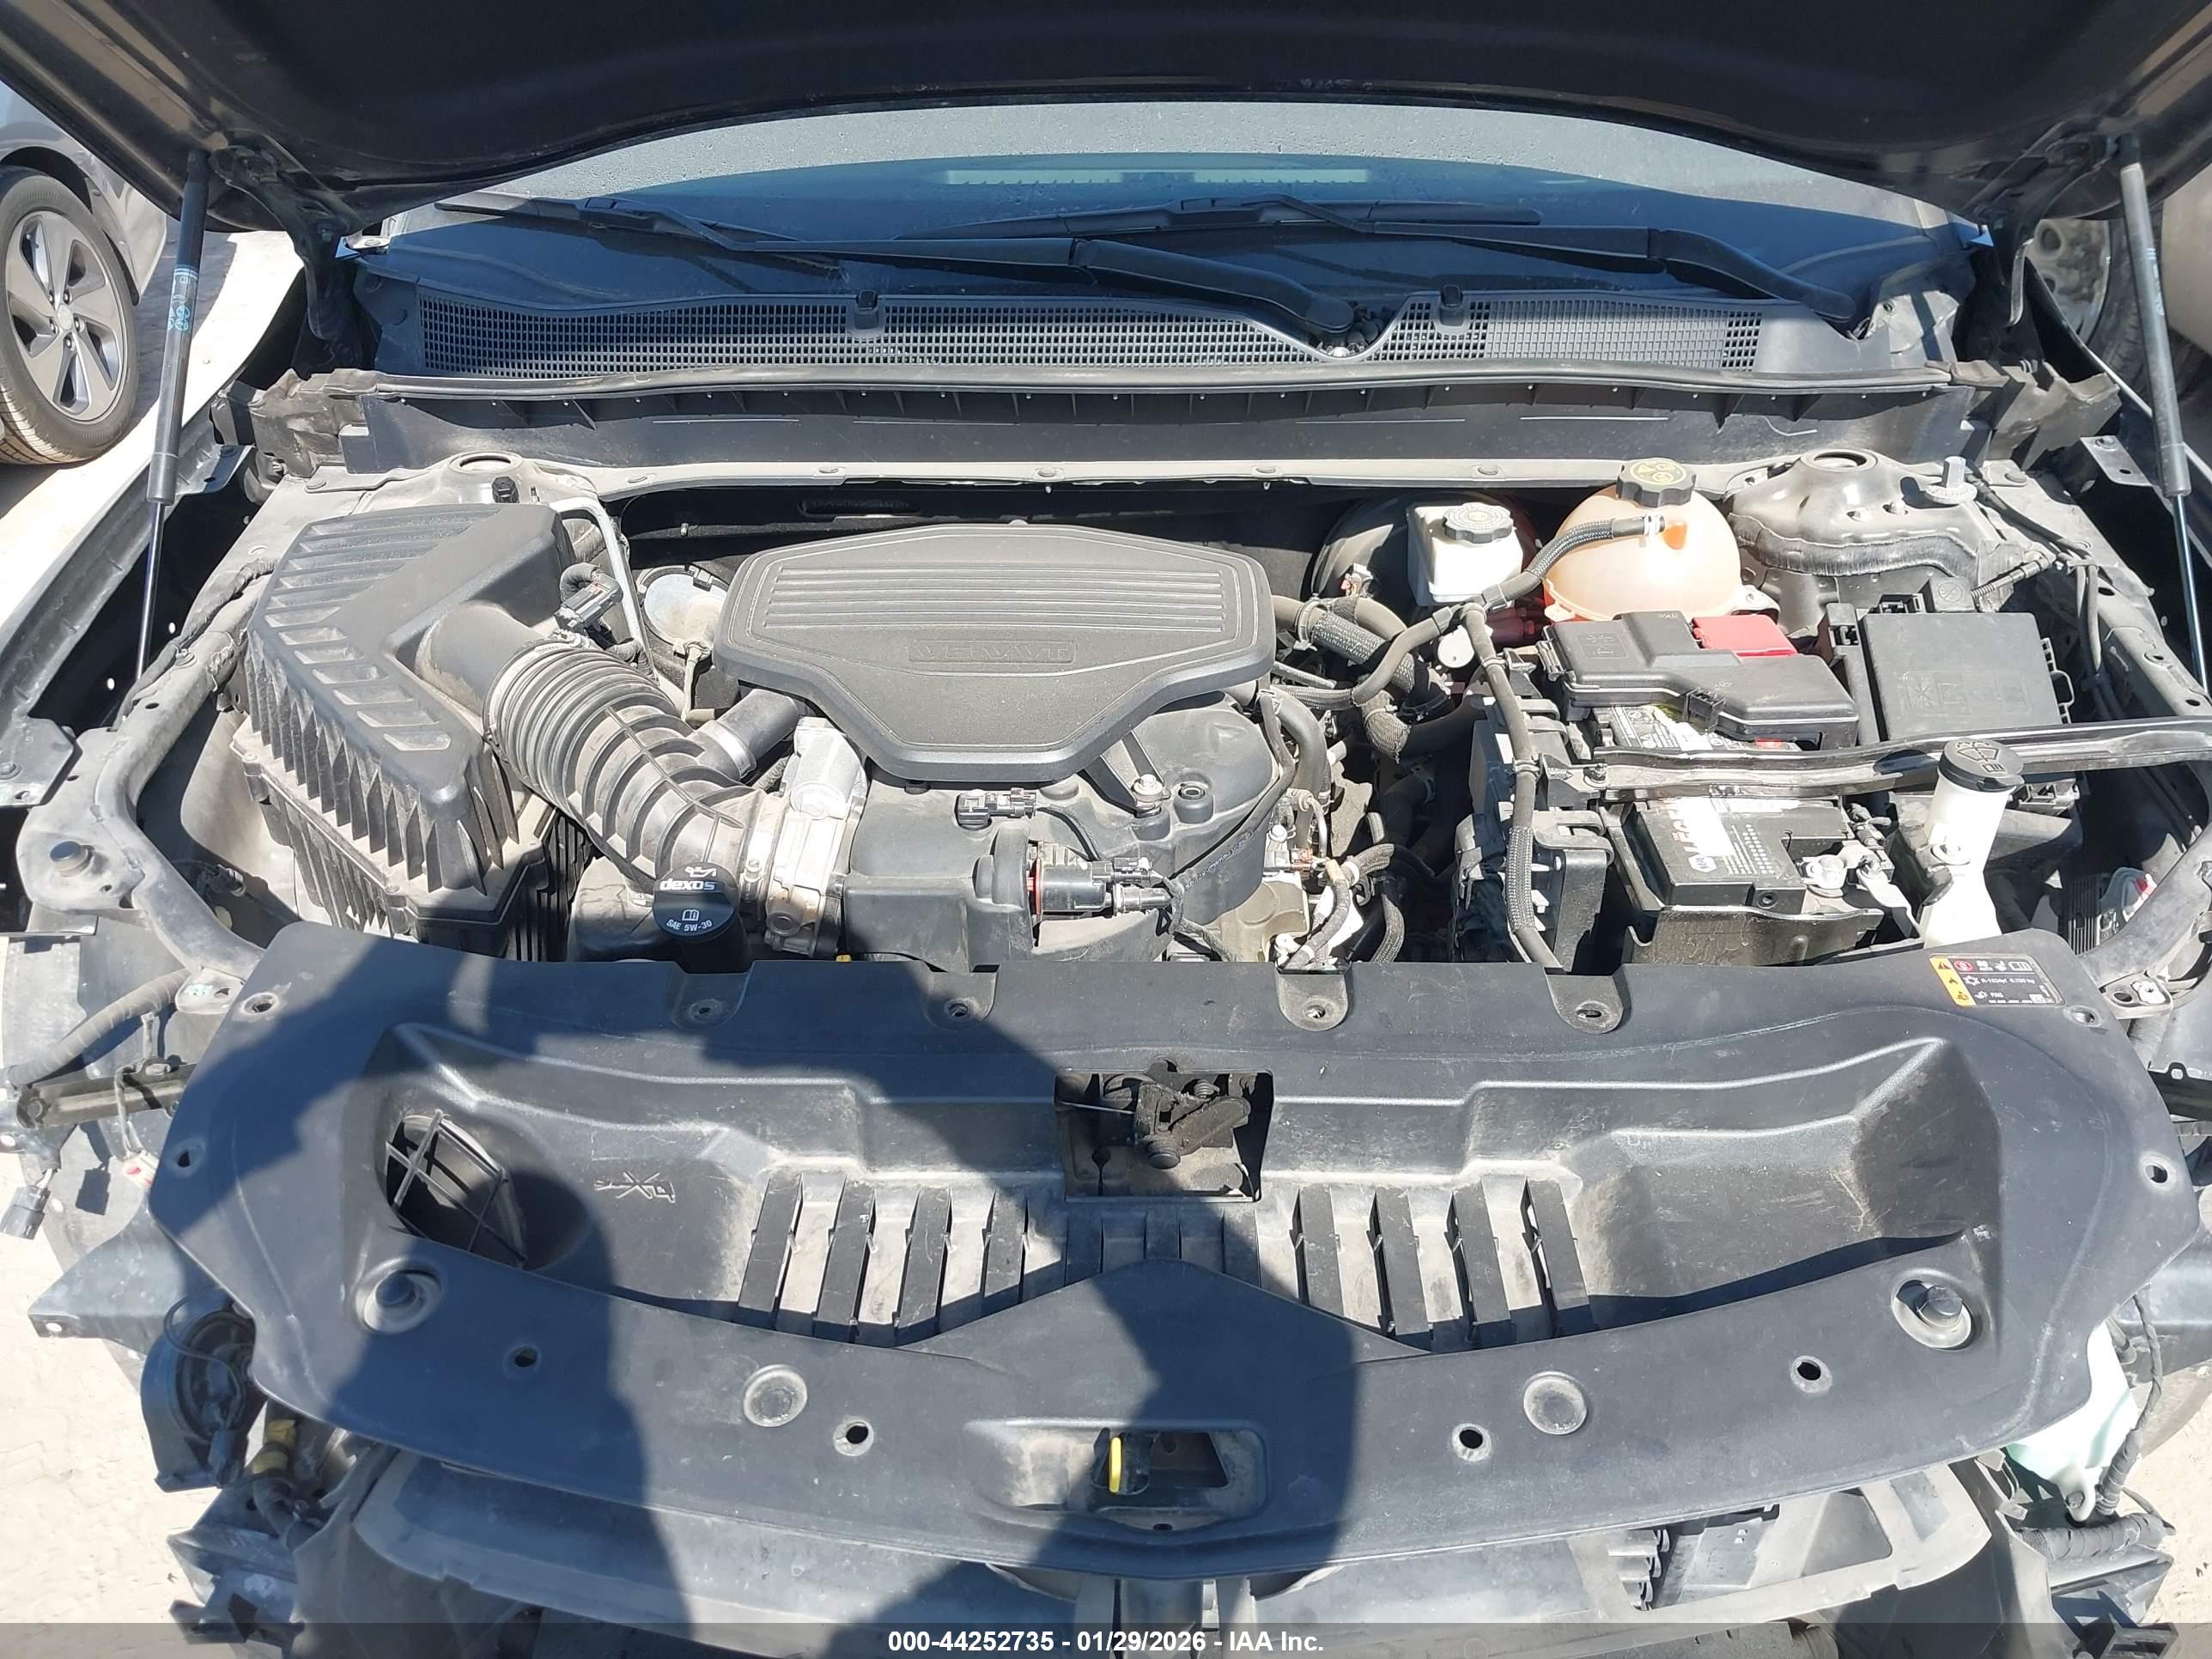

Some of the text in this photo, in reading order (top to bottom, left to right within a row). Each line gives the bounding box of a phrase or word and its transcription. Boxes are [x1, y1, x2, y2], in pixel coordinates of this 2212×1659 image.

[660, 878, 715, 890] dexos
[667, 919, 713, 933] SAE 5W-30
